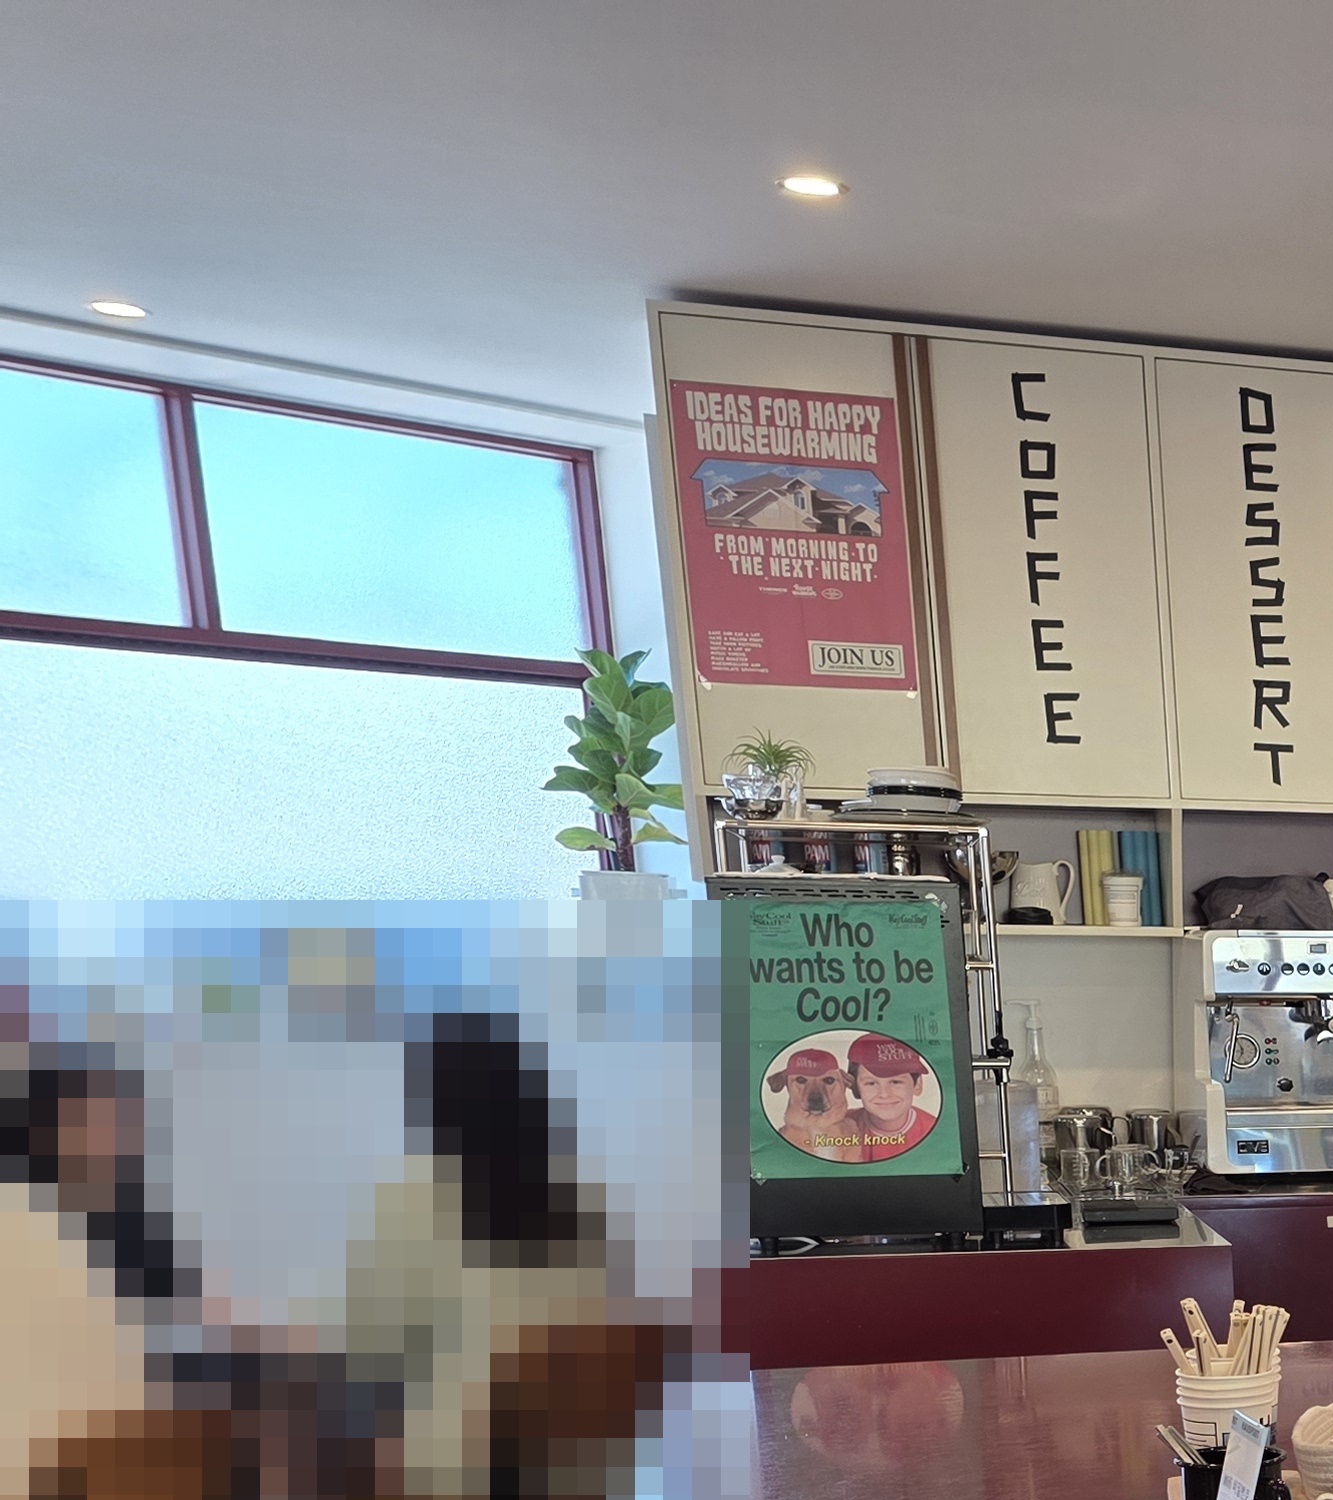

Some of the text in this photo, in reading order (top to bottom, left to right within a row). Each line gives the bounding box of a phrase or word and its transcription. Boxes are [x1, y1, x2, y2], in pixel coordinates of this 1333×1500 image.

[685, 390, 881, 434] IDEAS FOR HAPPY
[695, 421, 878, 464] HOUSEWARMING
[714, 533, 878, 563] FROM MORNING TO
[1011, 372, 1081, 744] COFFEE
[728, 555, 873, 582] THE NEXT NIGHT
[1239, 387, 1294, 786] DESSERT
[818, 647, 896, 668] JOIN US
[804, 844, 830, 862] PAM
[800, 913, 874, 948] Who
[750, 950, 934, 984] wants to be
[797, 987, 891, 1023] Cool?
[815, 1133, 905, 1148] Knock knock
